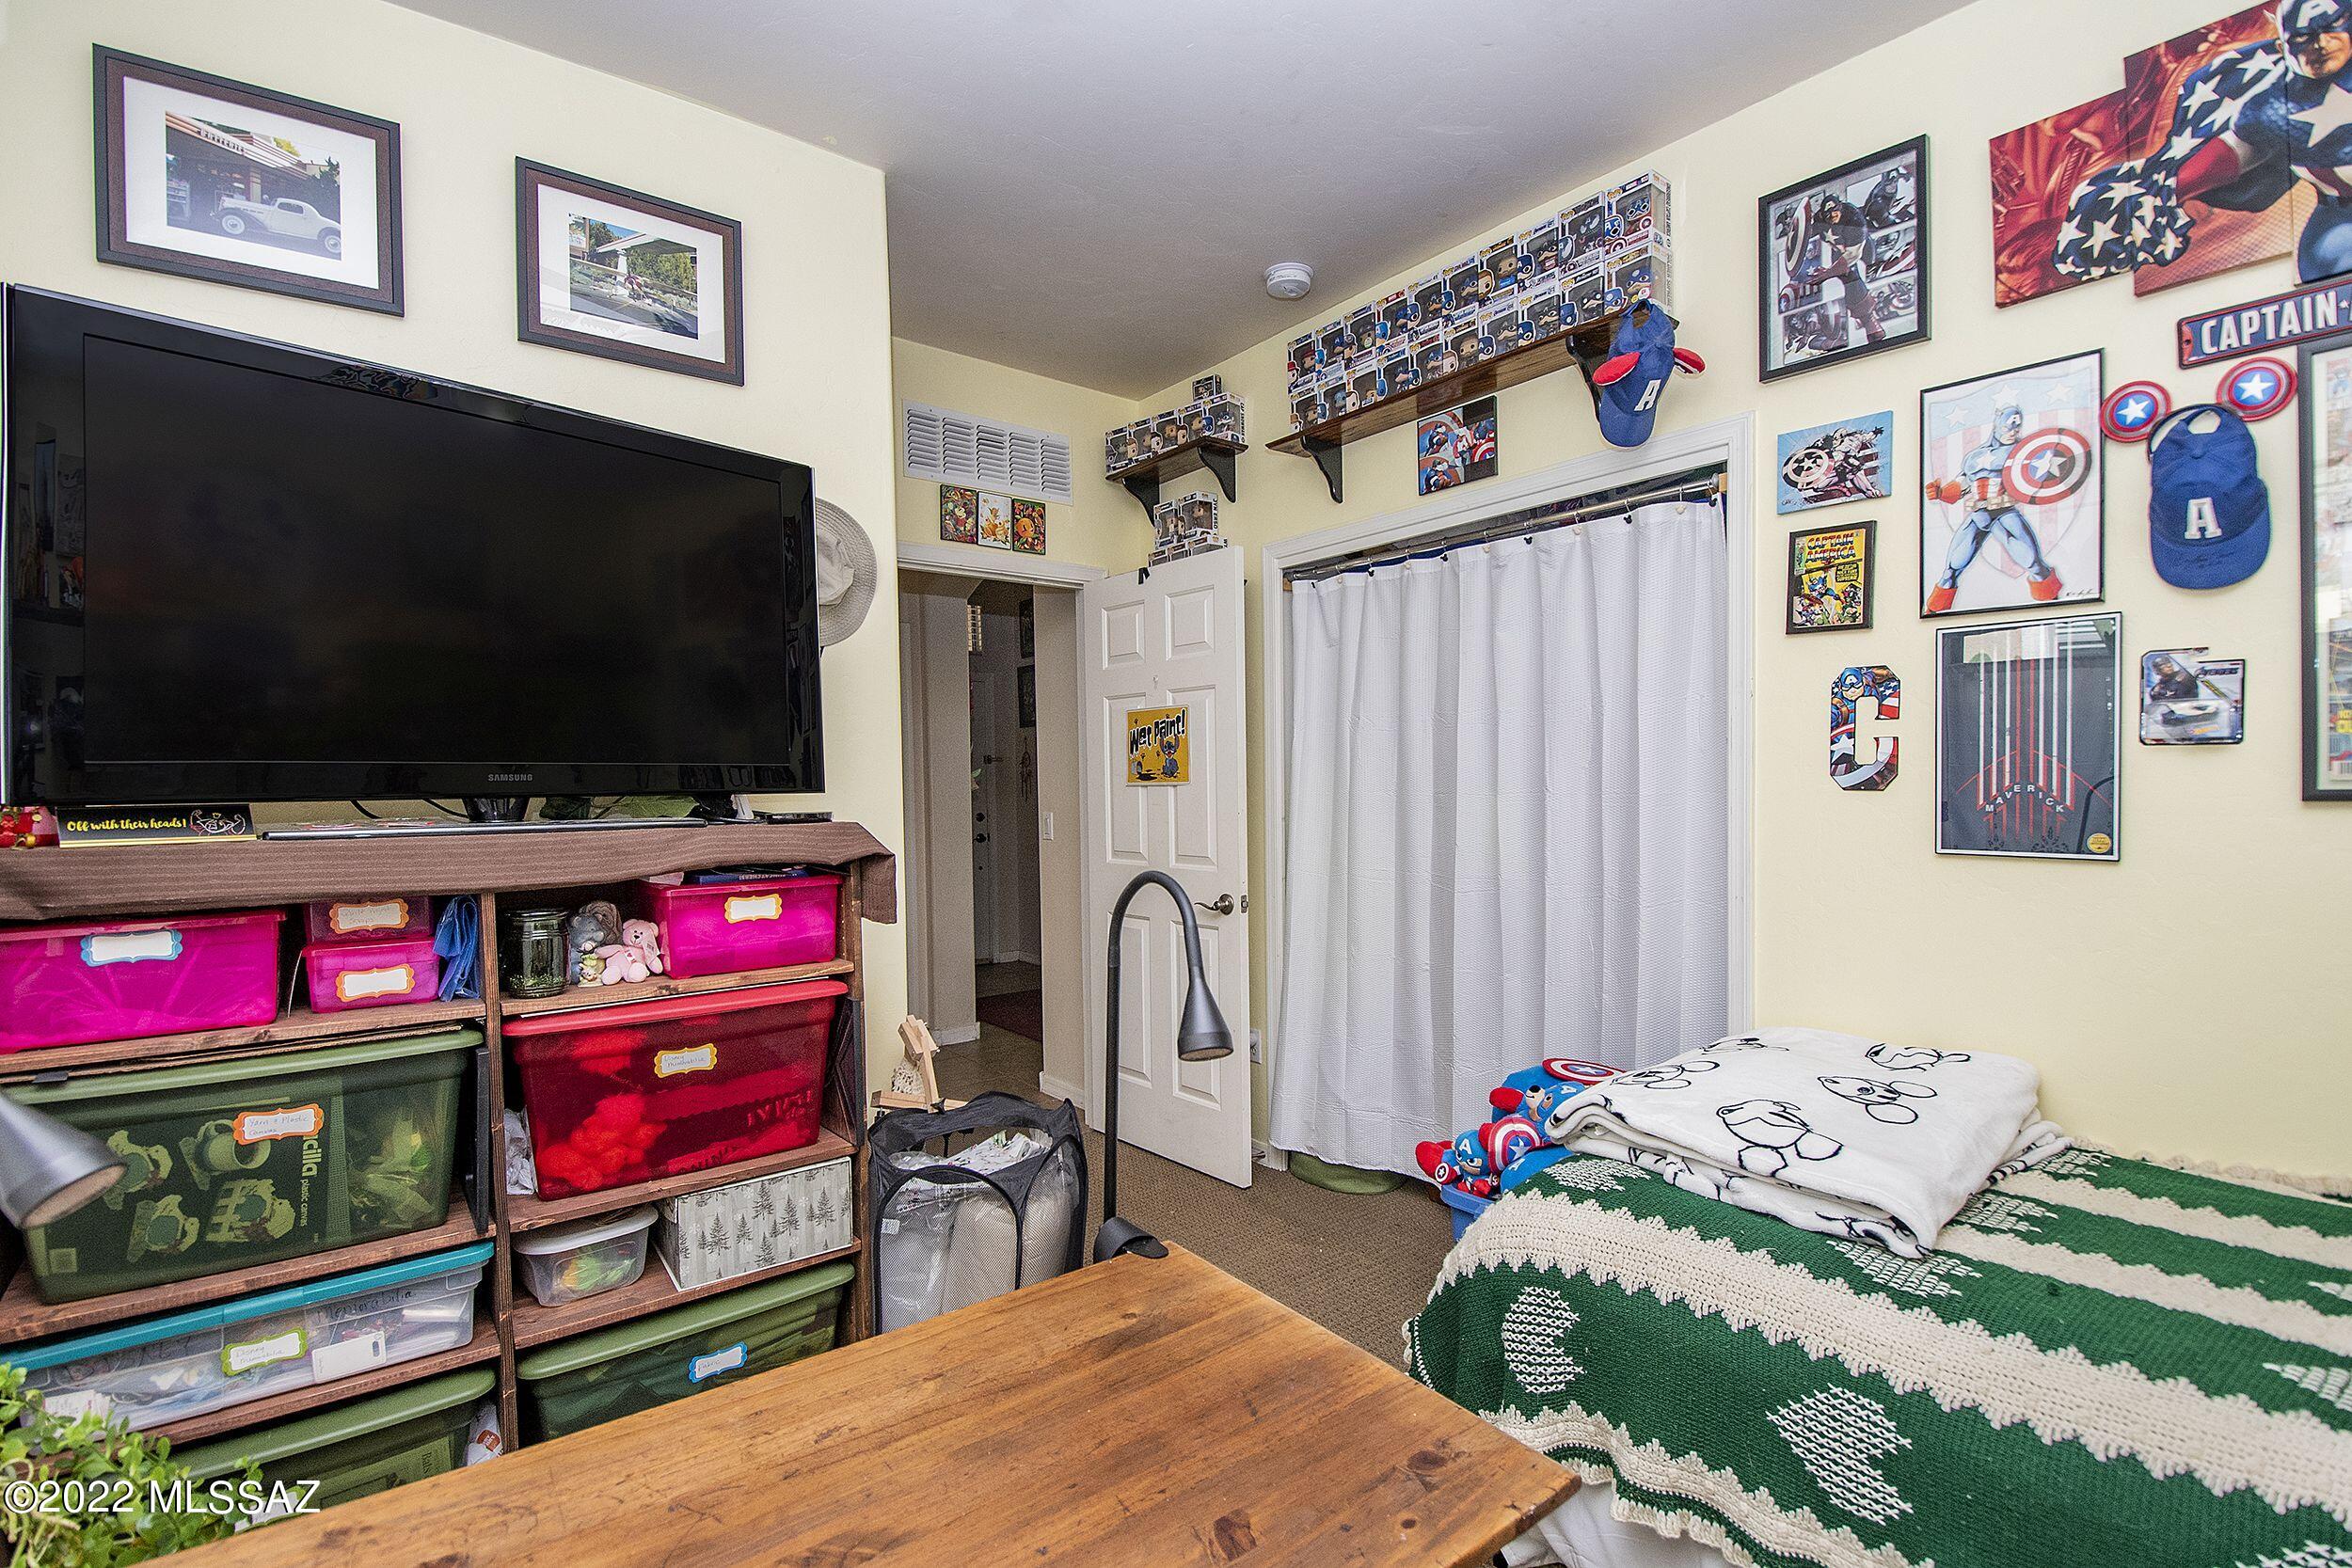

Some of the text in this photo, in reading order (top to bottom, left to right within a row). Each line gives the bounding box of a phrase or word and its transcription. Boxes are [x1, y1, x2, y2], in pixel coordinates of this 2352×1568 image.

[2201, 290, 2339, 355] CAPTAIN
[1633, 378, 1662, 412] A
[2184, 496, 2222, 540] A
[1806, 531, 1855, 550] CAPTAIN
[1805, 546, 1857, 562] AMERICA
[1130, 724, 1153, 756] Wet
[487, 773, 534, 783] SAMSUNG
[1984, 784, 2065, 814] MAVERICK
[67, 817, 187, 832] Off with their heads!
[1459, 1138, 1473, 1155] A
[300, 1179, 310, 1202] plastic
[300, 1203, 310, 1227] canvas
